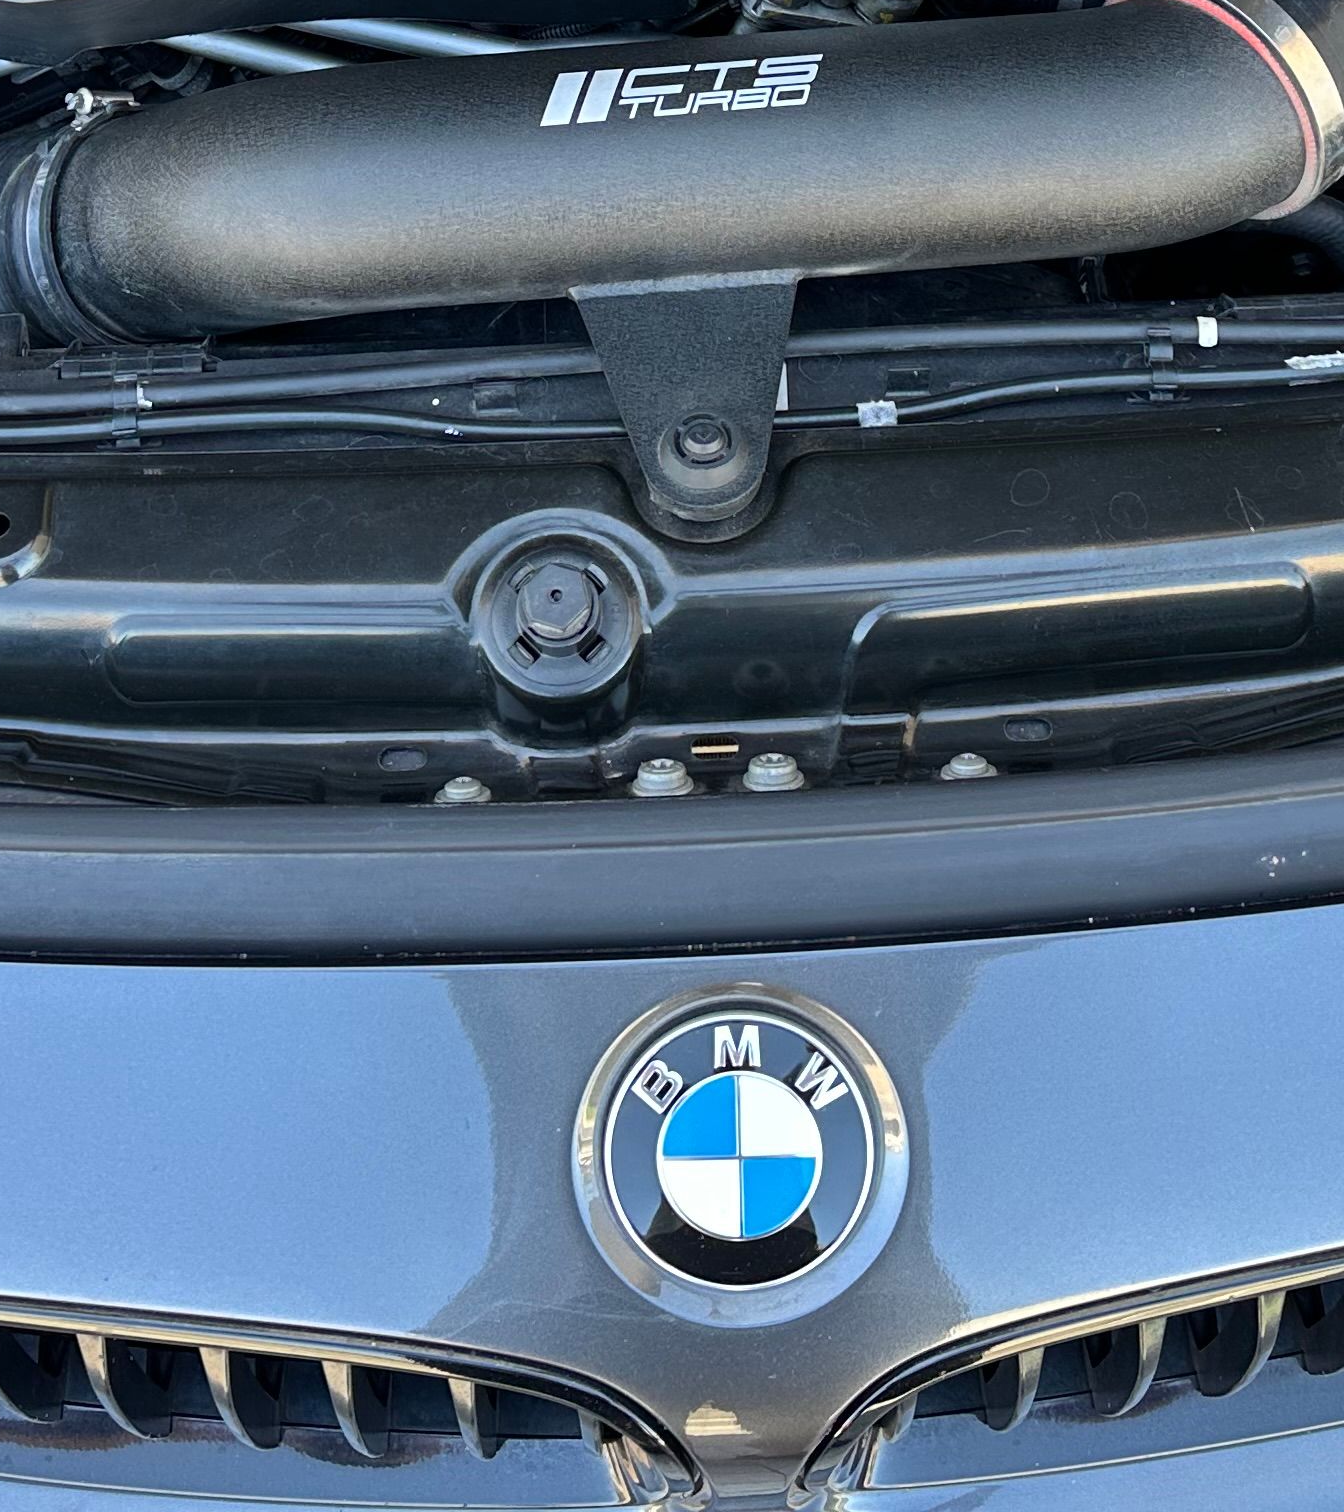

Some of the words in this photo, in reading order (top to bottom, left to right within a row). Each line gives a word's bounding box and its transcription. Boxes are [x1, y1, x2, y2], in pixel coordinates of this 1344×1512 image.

[620, 53, 823, 97] CTS
[618, 84, 812, 120] TURBO
[631, 1024, 849, 1115] BMW
